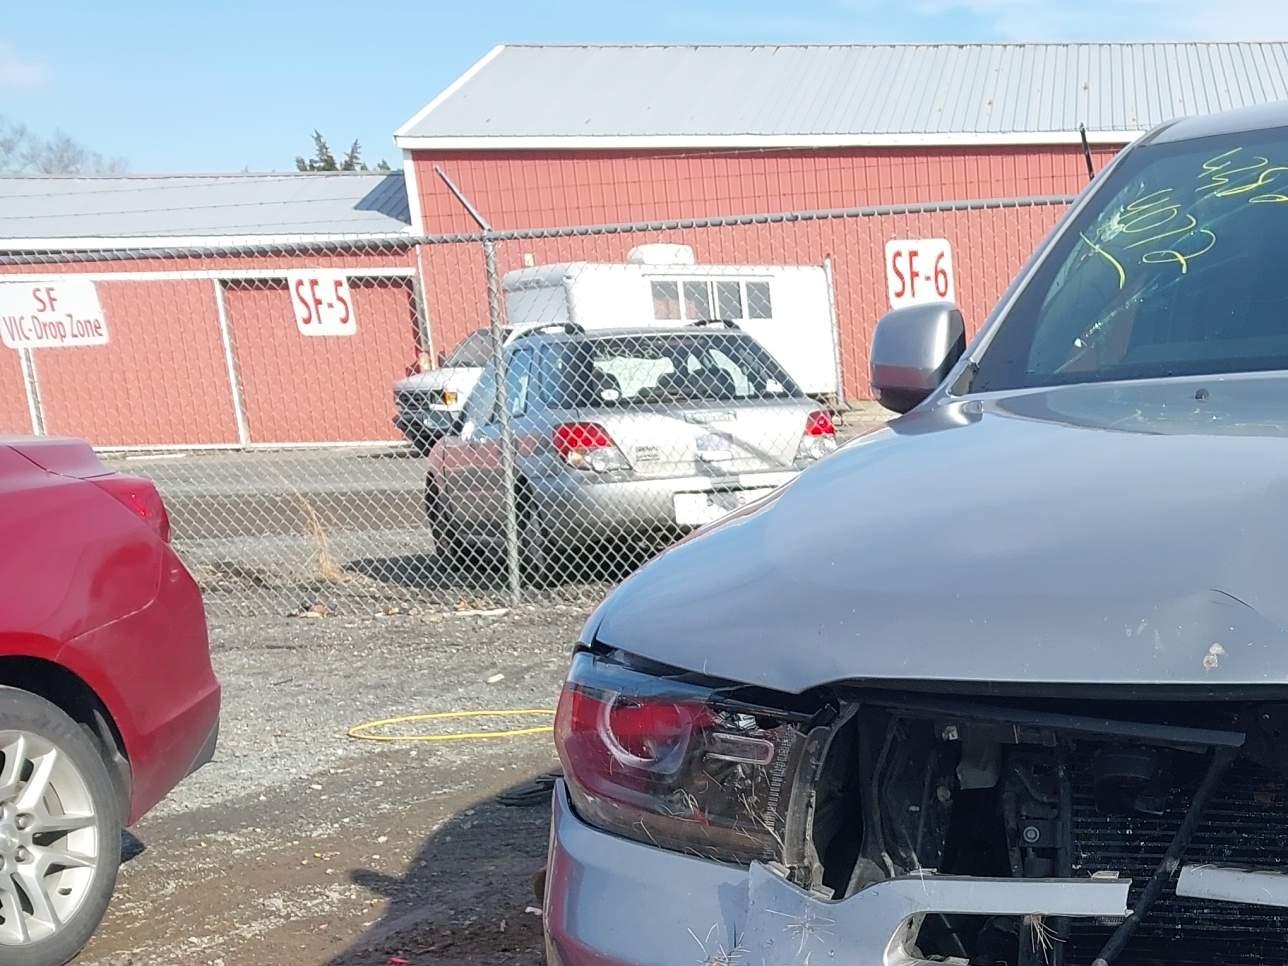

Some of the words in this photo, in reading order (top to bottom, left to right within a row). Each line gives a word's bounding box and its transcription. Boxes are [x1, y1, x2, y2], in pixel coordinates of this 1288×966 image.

[892, 250, 948, 298] SF-6
[32, 287, 57, 312] SF
[295, 279, 349, 324] SF-5
[3, 315, 66, 342] VIC-Drop
[66, 313, 103, 337] Zone
